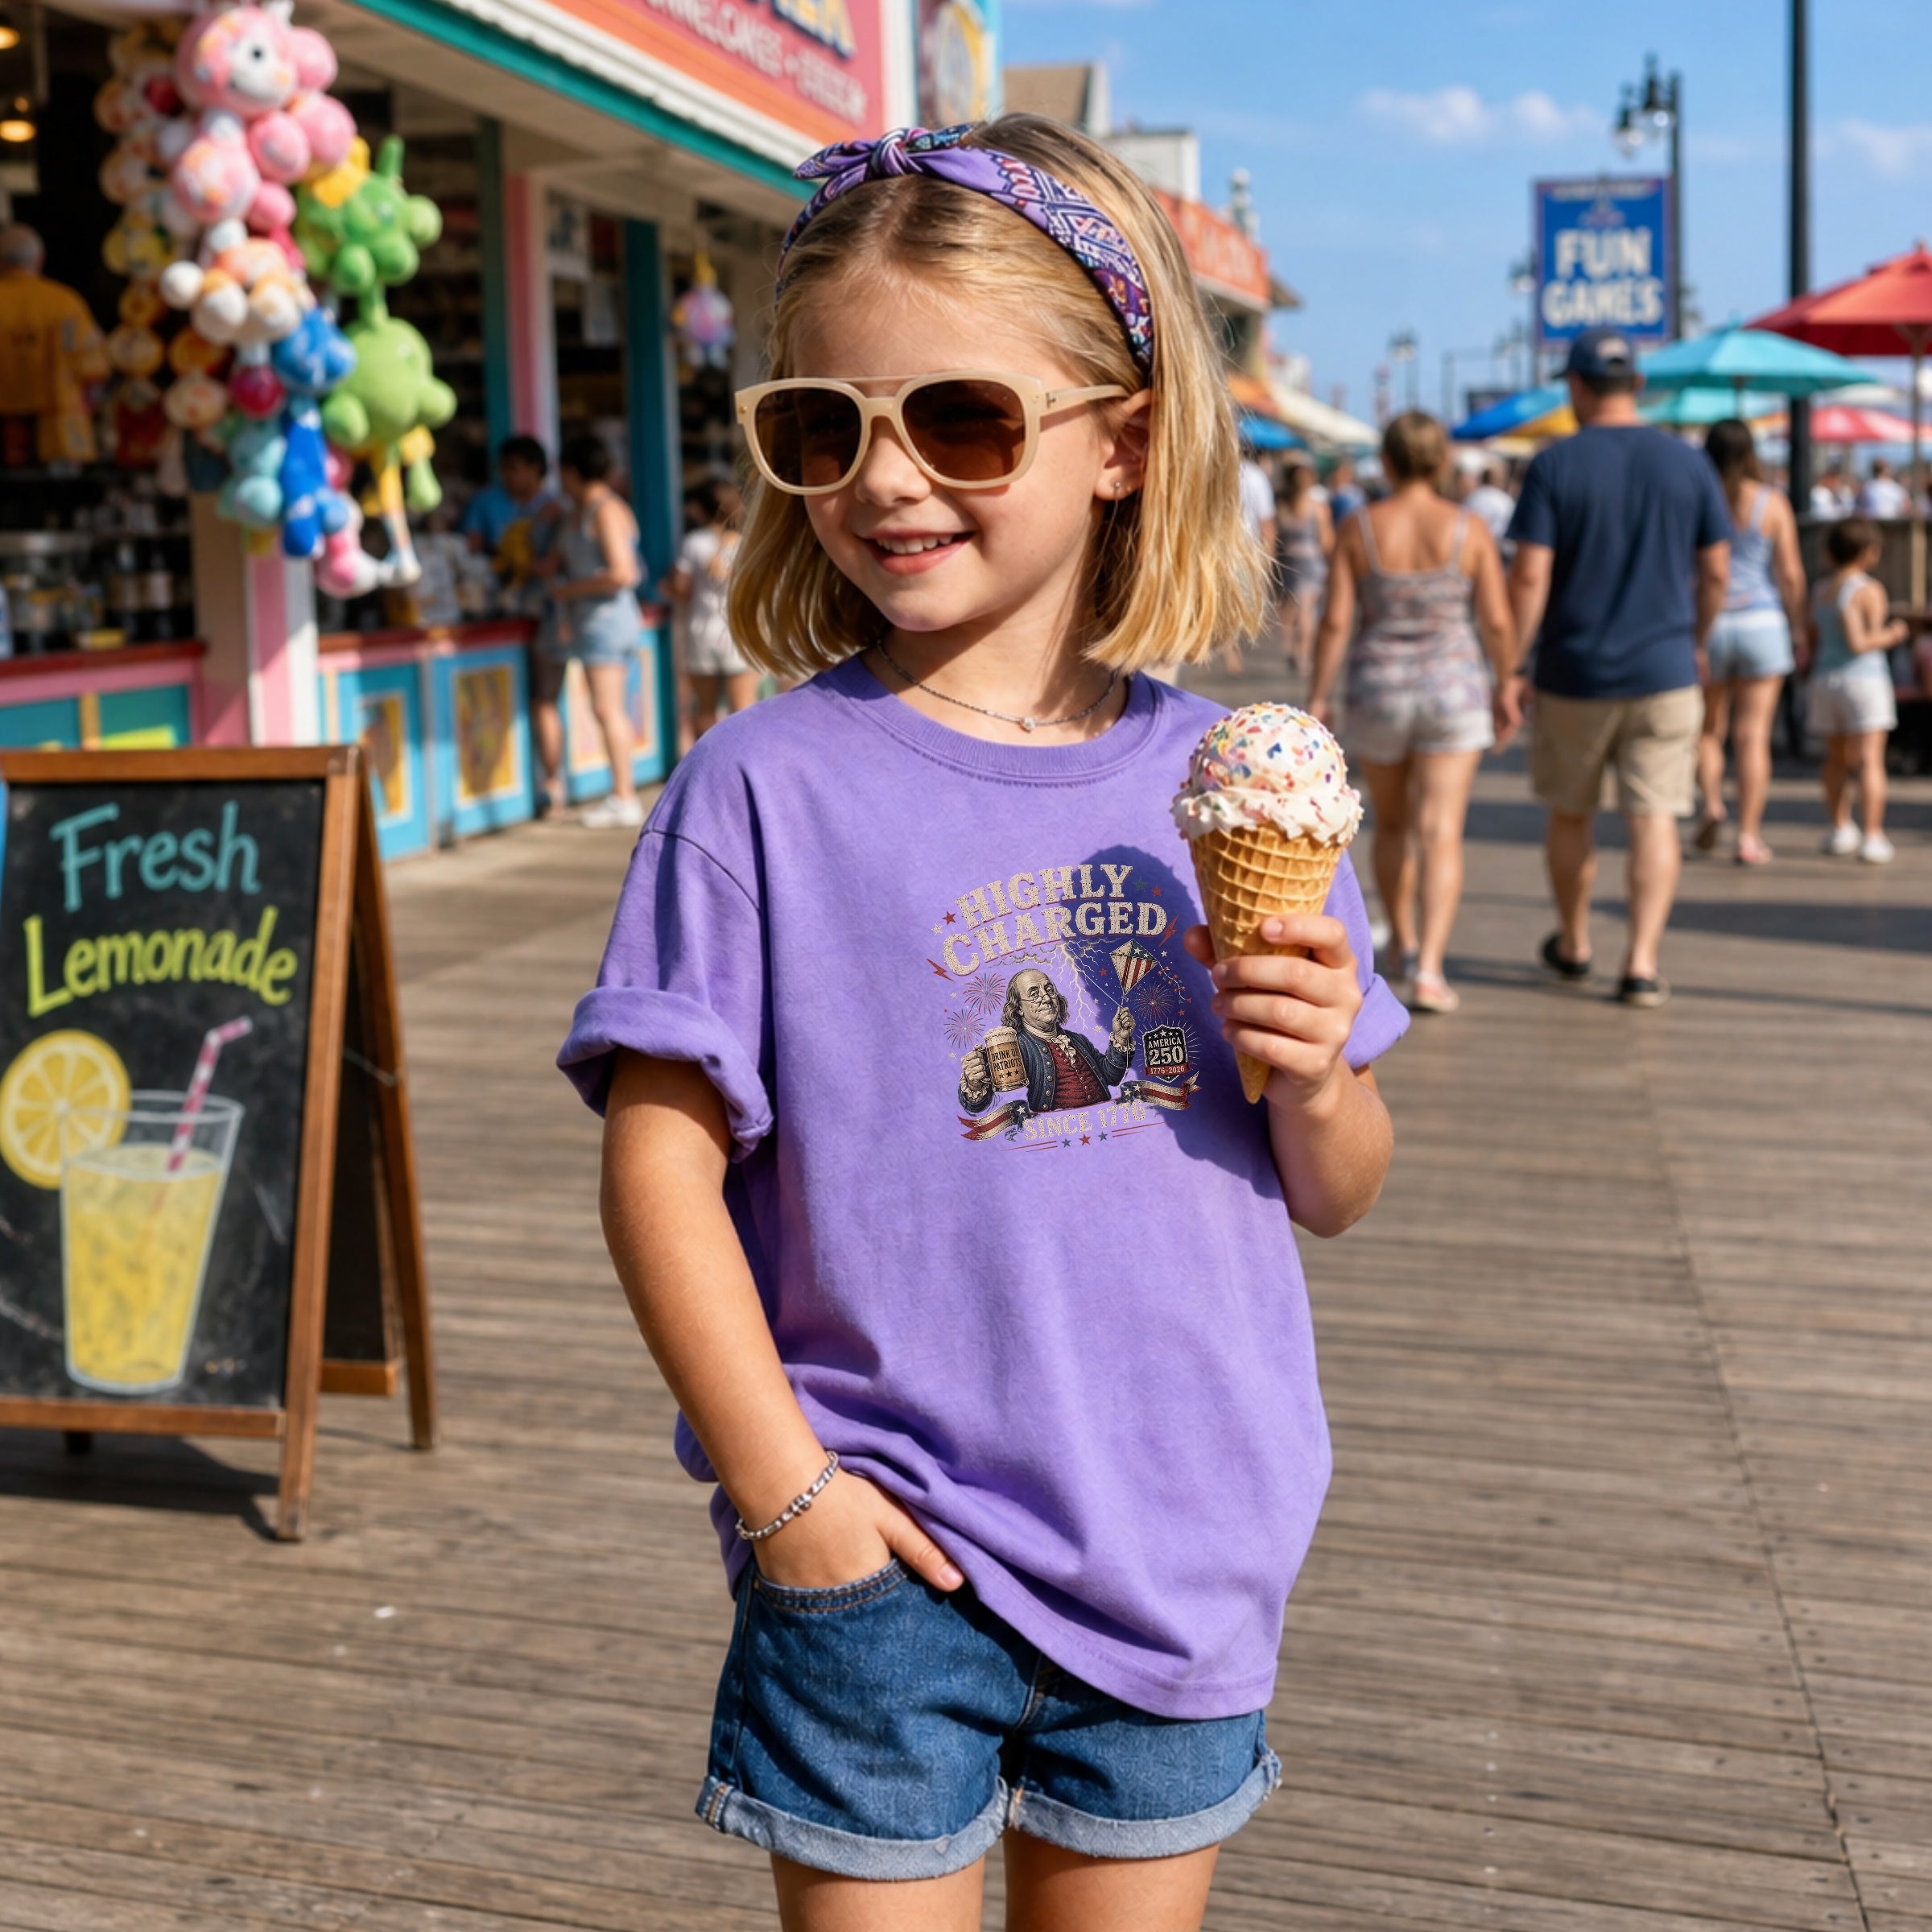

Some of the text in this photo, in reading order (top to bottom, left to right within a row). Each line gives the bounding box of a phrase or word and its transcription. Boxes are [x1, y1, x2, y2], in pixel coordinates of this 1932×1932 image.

[1554, 226, 1653, 279] FUN
[1541, 275, 1665, 328] GAMES
[49, 799, 262, 914] Fresh
[955, 864, 1133, 931] HIGHLY
[23, 905, 299, 1019] Lemonade
[942, 902, 1168, 976] CHARGED
[990, 1049, 1011, 1063] DRINK
[992, 1057, 1023, 1072] PATRIOTS
[1148, 1036, 1183, 1049] AMERICA
[1149, 1045, 1184, 1066] 250
[1150, 1065, 1185, 1075] 1776-2026
[1021, 1098, 1146, 1141] SINCE 1776
